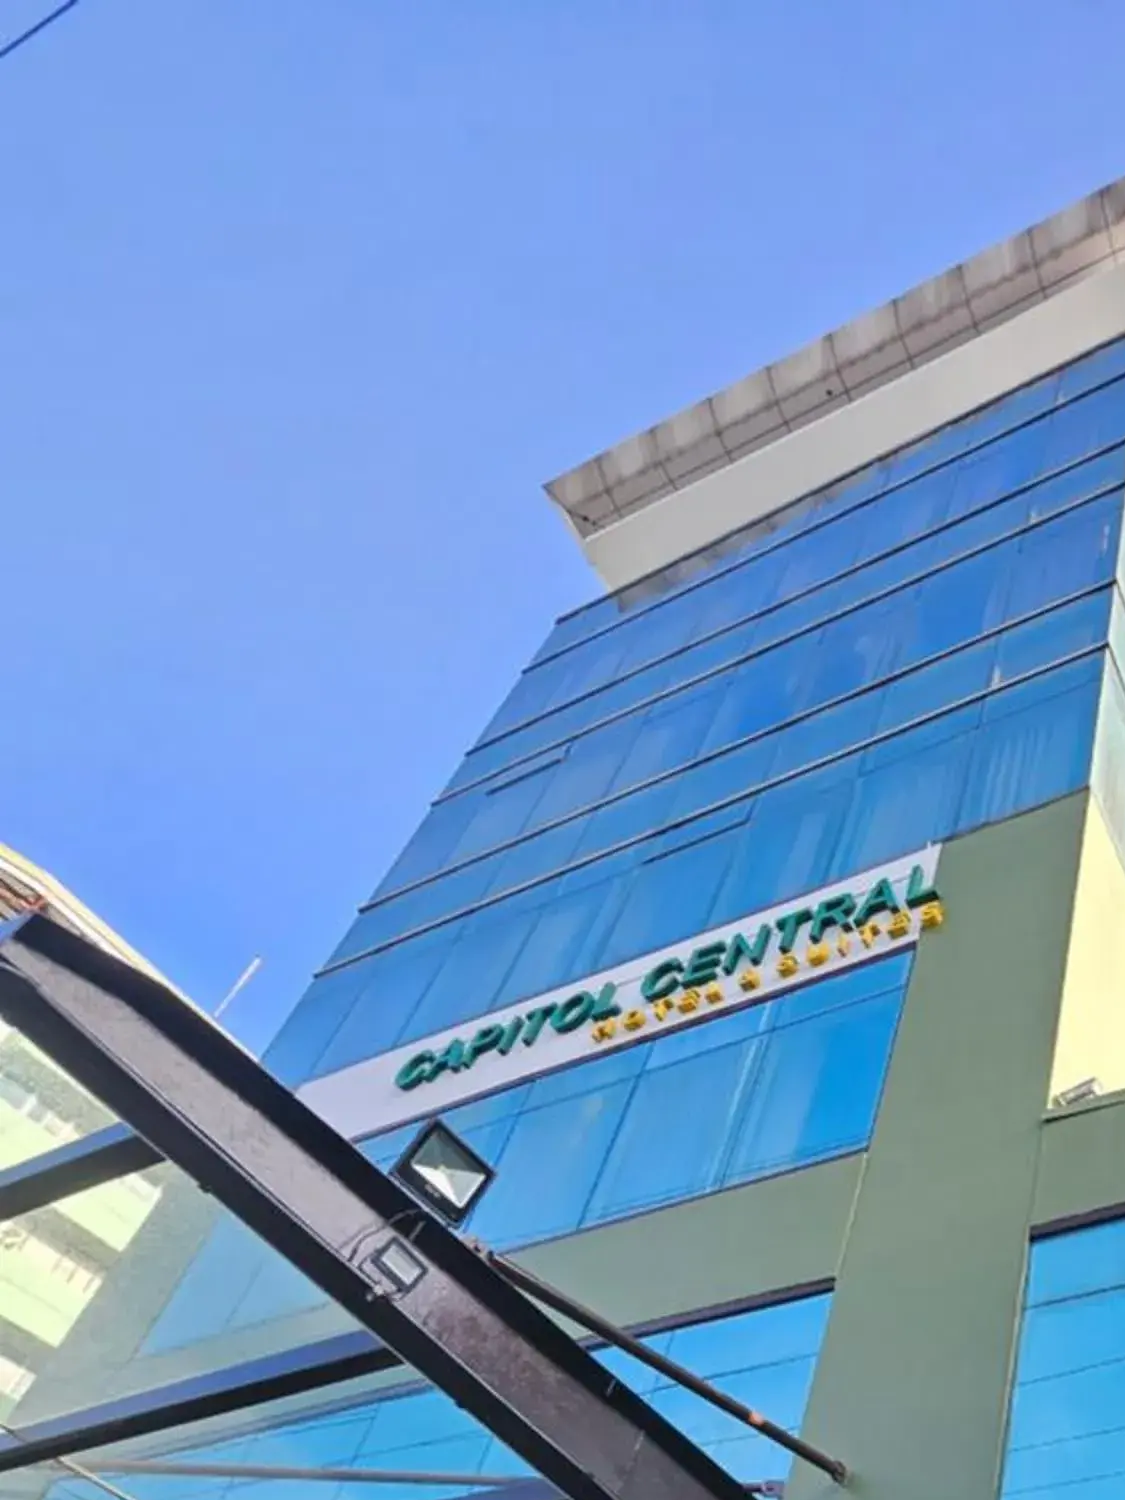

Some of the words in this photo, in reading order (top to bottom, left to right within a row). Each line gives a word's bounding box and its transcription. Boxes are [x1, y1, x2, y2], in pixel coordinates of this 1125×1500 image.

[395, 982, 622, 1092] CAPITOL
[640, 864, 940, 1003] CENTRAL
[591, 982, 724, 1043] HOTEL
[776, 901, 945, 978] SUITES
